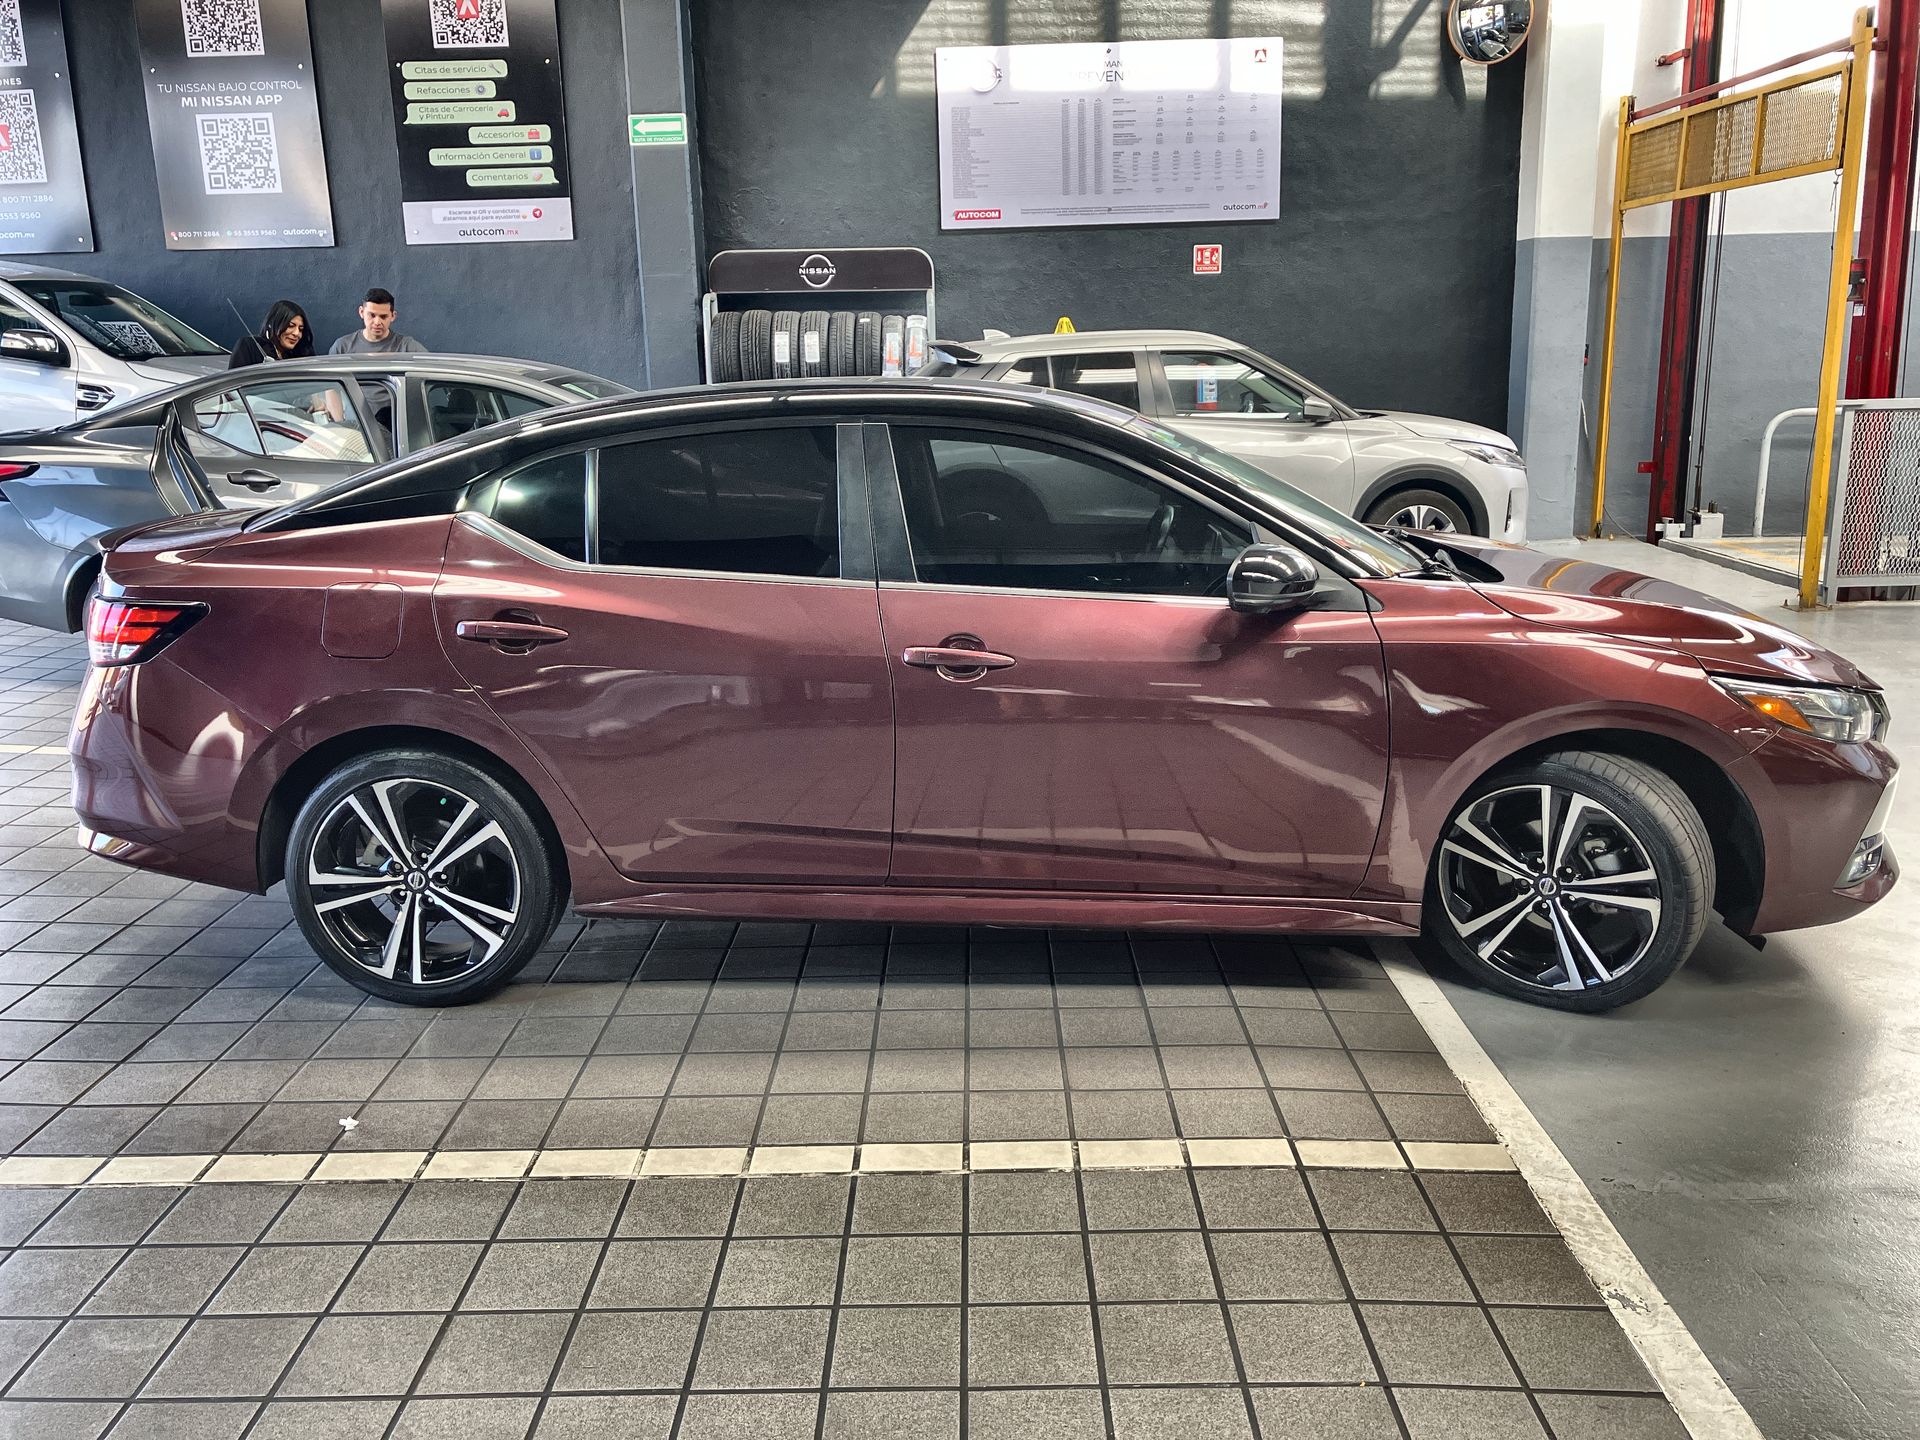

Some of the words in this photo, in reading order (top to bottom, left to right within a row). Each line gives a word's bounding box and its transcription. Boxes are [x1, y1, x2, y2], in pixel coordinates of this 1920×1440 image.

[415, 66, 437, 74] Citas
[440, 66, 451, 74] de
[453, 65, 487, 74] servicio
[157, 84, 173, 93] TU
[175, 82, 216, 93] NISSAN
[218, 82, 247, 92] BAJO
[249, 80, 303, 91] CONTROL
[416, 86, 471, 95] Refacciones
[181, 97, 198, 107] MI
[201, 95, 252, 107] NISSAN
[255, 94, 283, 106] APP
[452, 105, 494, 113] Carrocería
[477, 130, 525, 139] Accesorios
[437, 152, 491, 161] Información
[492, 151, 527, 160] General
[471, 172, 529, 182] Comentarios
[957, 211, 999, 219] AUTOCOM
